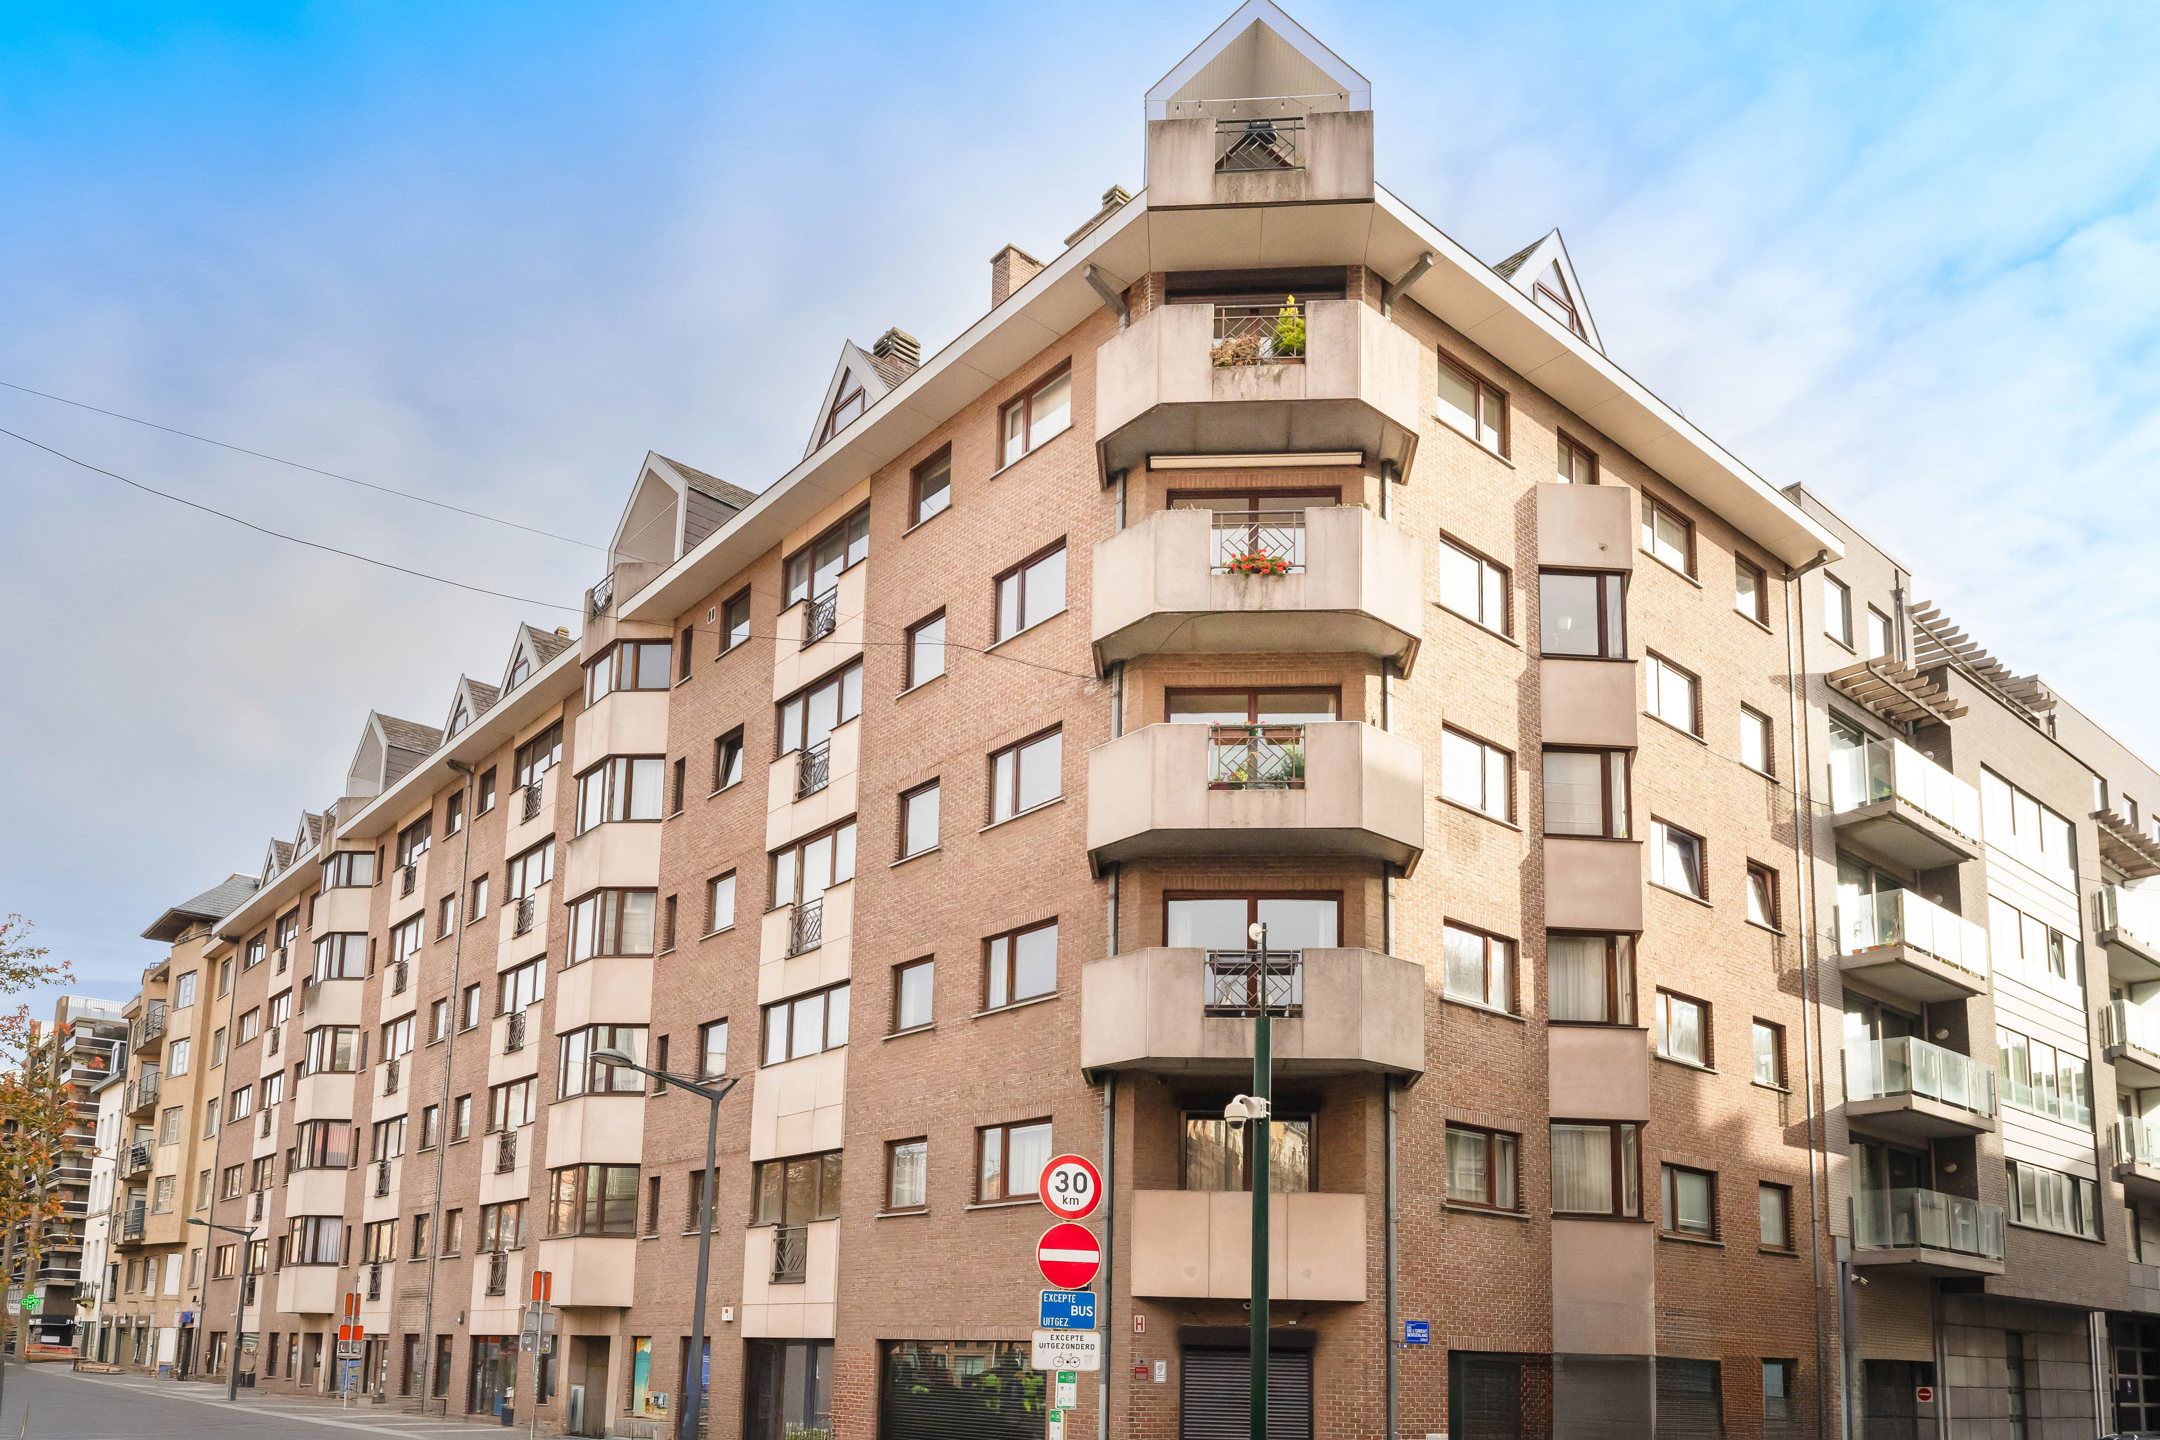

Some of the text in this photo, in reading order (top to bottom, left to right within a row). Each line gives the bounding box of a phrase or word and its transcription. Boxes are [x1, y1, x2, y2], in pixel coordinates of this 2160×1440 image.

[1055, 1170, 1088, 1194] 30
[1062, 1194, 1079, 1205] km
[1043, 1293, 1076, 1304] EXCEPTE
[1070, 1305, 1094, 1317] BUS
[1136, 1317, 1143, 1331] H
[1050, 1334, 1084, 1342] EXCEPTE
[1039, 1342, 1095, 1350] UITGEZONDERD
